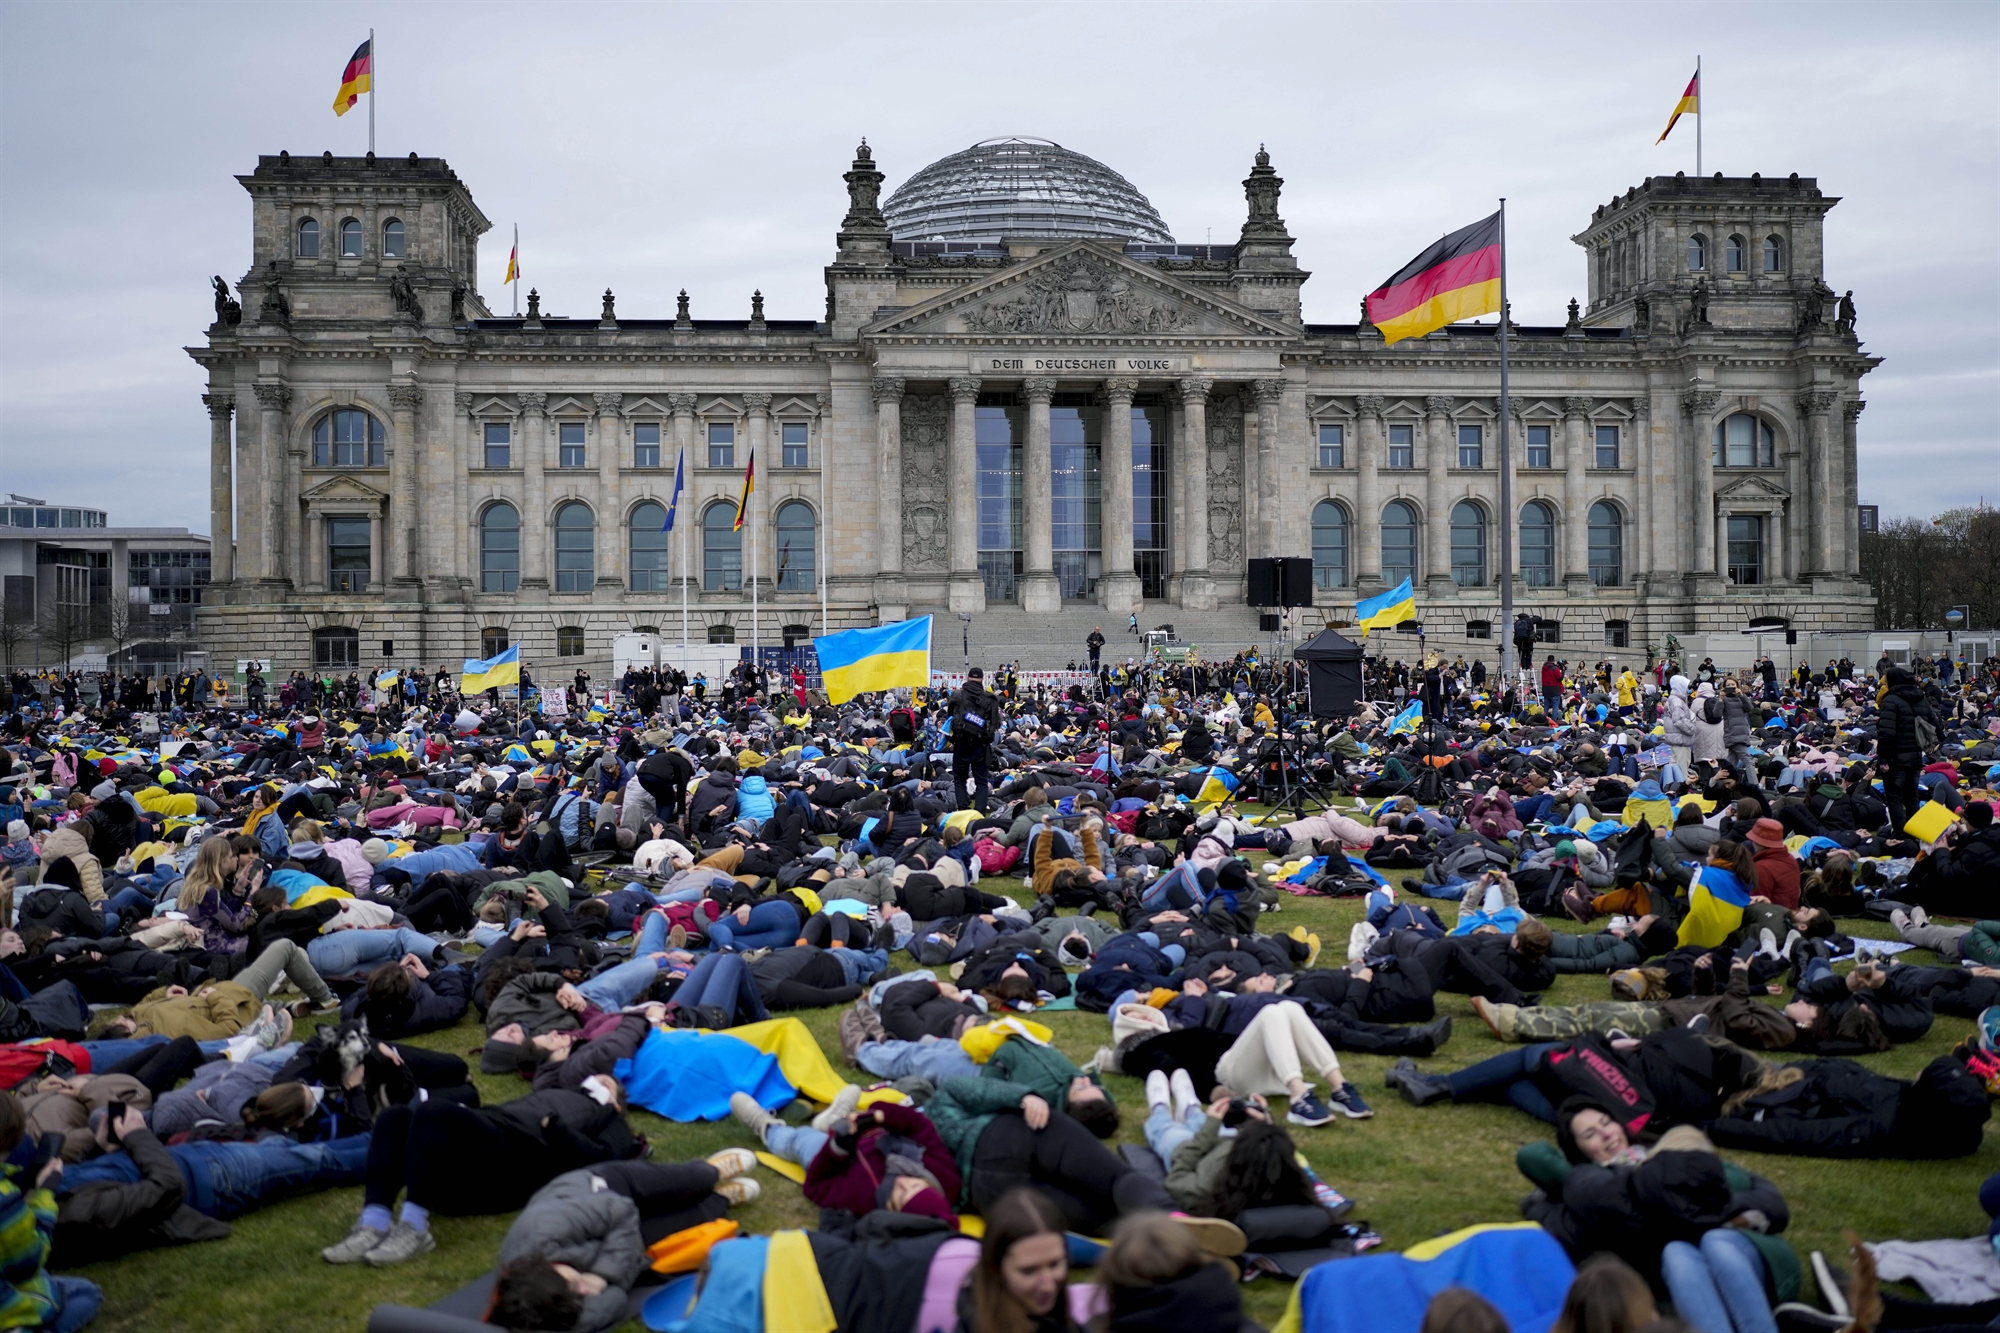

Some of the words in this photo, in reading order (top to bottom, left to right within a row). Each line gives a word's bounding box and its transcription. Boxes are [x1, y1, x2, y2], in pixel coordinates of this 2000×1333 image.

[992, 359, 1023, 369] DEM
[1035, 359, 1116, 369] DEUTSCHEN
[1127, 359, 1170, 370] VOLKE
[966, 712, 984, 726] PRESS
